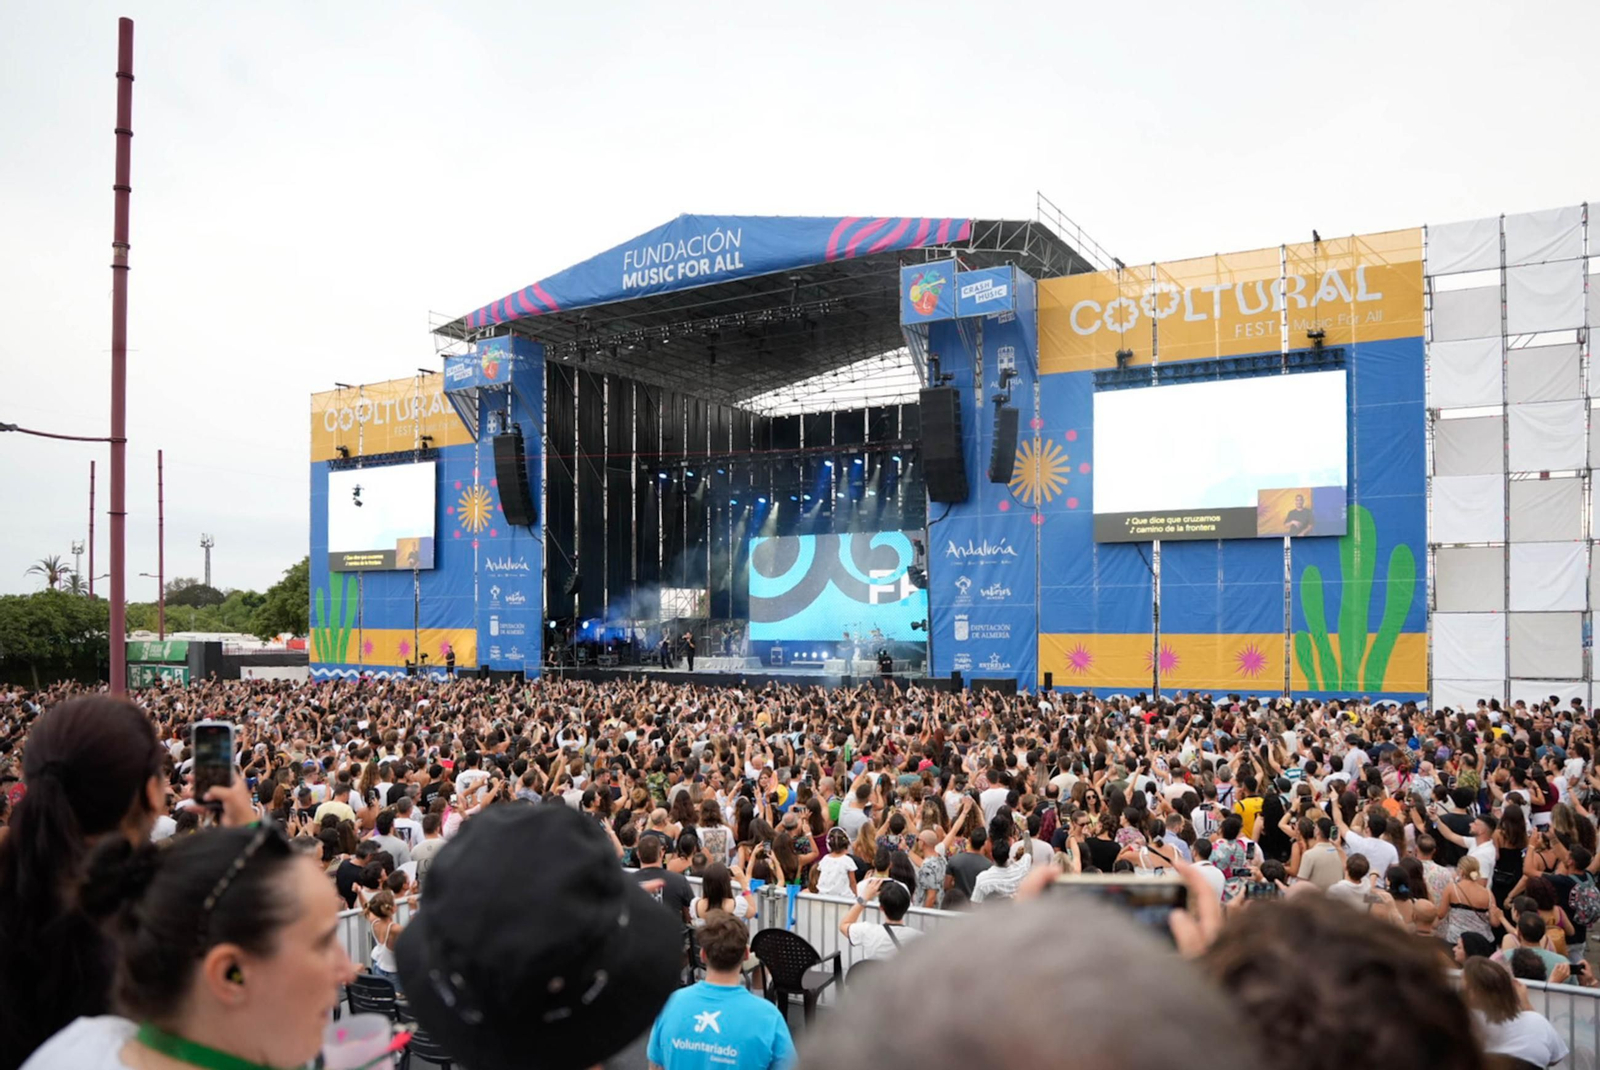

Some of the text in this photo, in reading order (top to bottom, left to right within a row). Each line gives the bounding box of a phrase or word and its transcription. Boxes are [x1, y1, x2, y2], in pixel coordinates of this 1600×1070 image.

[623, 227, 742, 271] FUNDACIÓN
[622, 251, 744, 290] MUSIC FOR ALL
[963, 282, 990, 295] CRASH
[977, 288, 1004, 301] MUSIC
[1069, 264, 1383, 336] COOLTURAL
[1235, 310, 1383, 338] FEST Music For All
[1131, 515, 1221, 525] Que dice que cruzamos
[1136, 524, 1216, 534] camino de la frontera
[946, 537, 1018, 559] Andalucía
[970, 623, 1011, 632] DIPUTACIÓN
[981, 631, 1010, 639] ALMERÍA
[671, 1038, 737, 1057] Voluntariado
